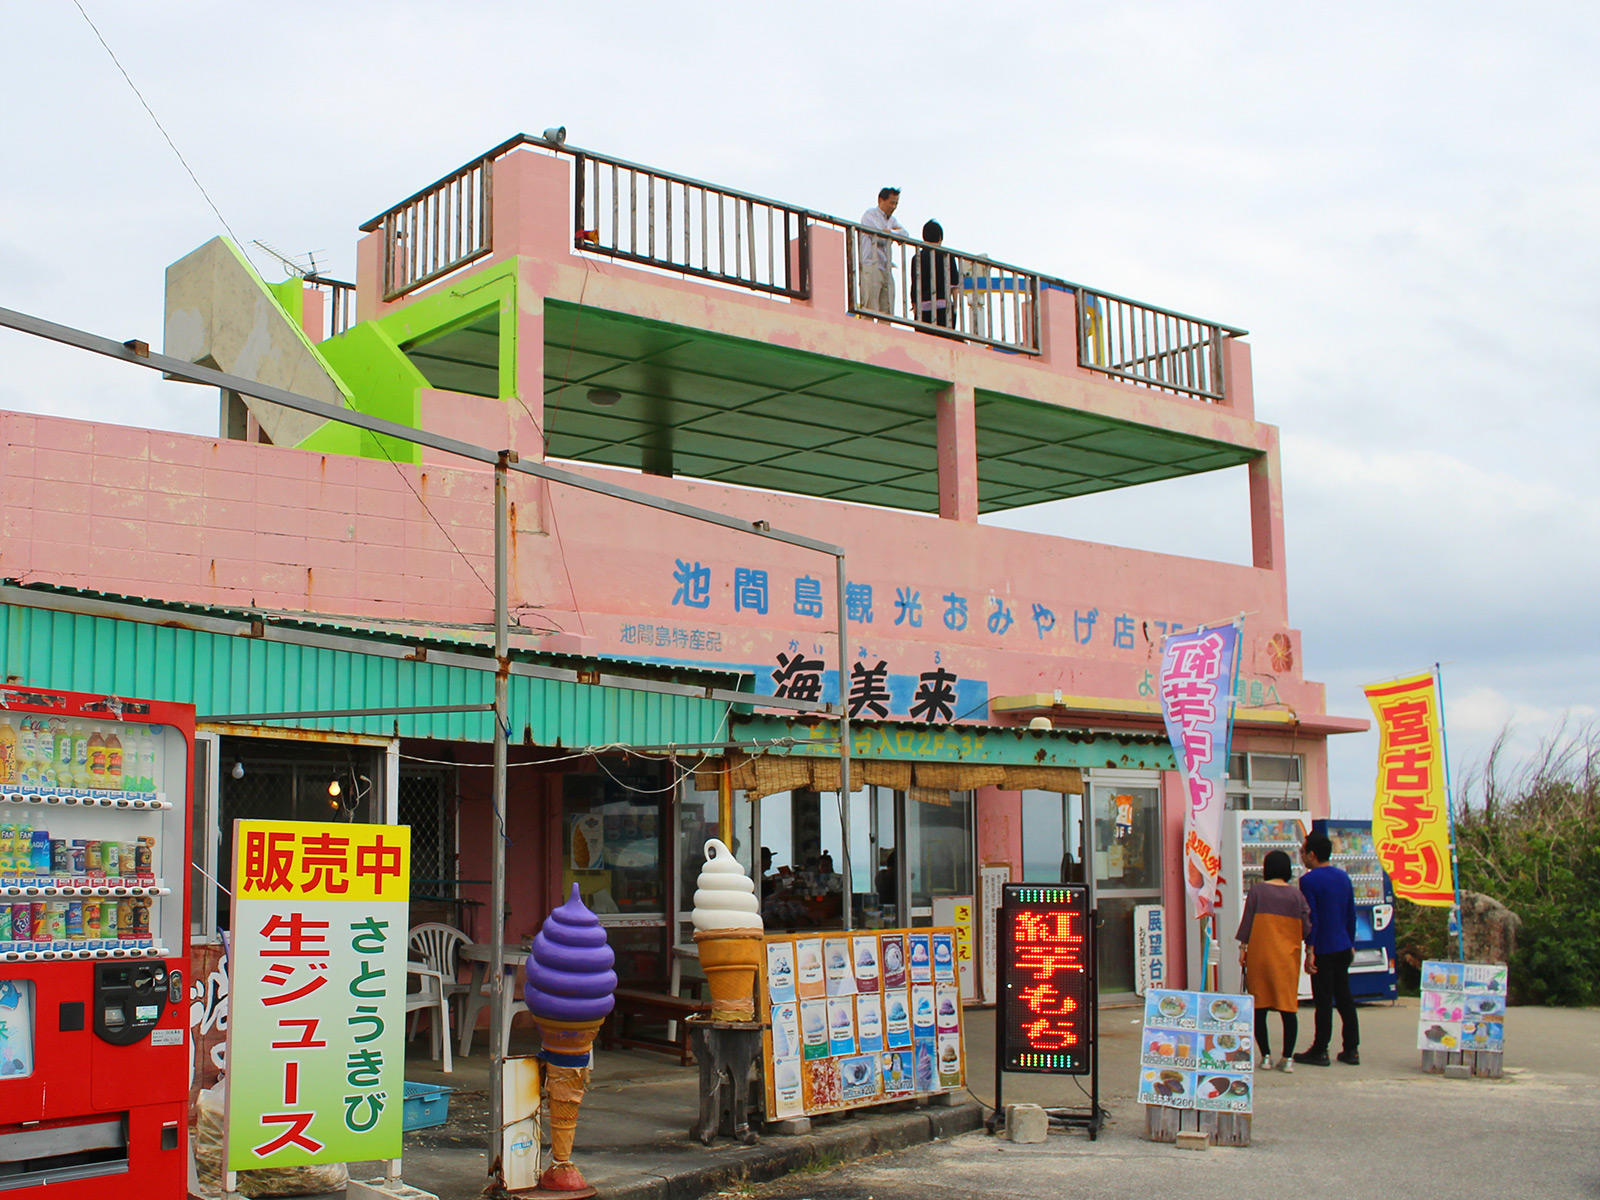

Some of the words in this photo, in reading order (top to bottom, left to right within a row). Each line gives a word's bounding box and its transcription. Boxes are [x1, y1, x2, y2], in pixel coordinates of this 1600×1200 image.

[619, 624, 723, 652] 池間島特産品
[672, 558, 1135, 650] 池間島観光おみやげ店
[771, 651, 957, 722] 海美来
[243, 831, 401, 895] 販売中
[253, 912, 330, 1156] 生ジュース
[344, 916, 389, 1132] さとうきび
